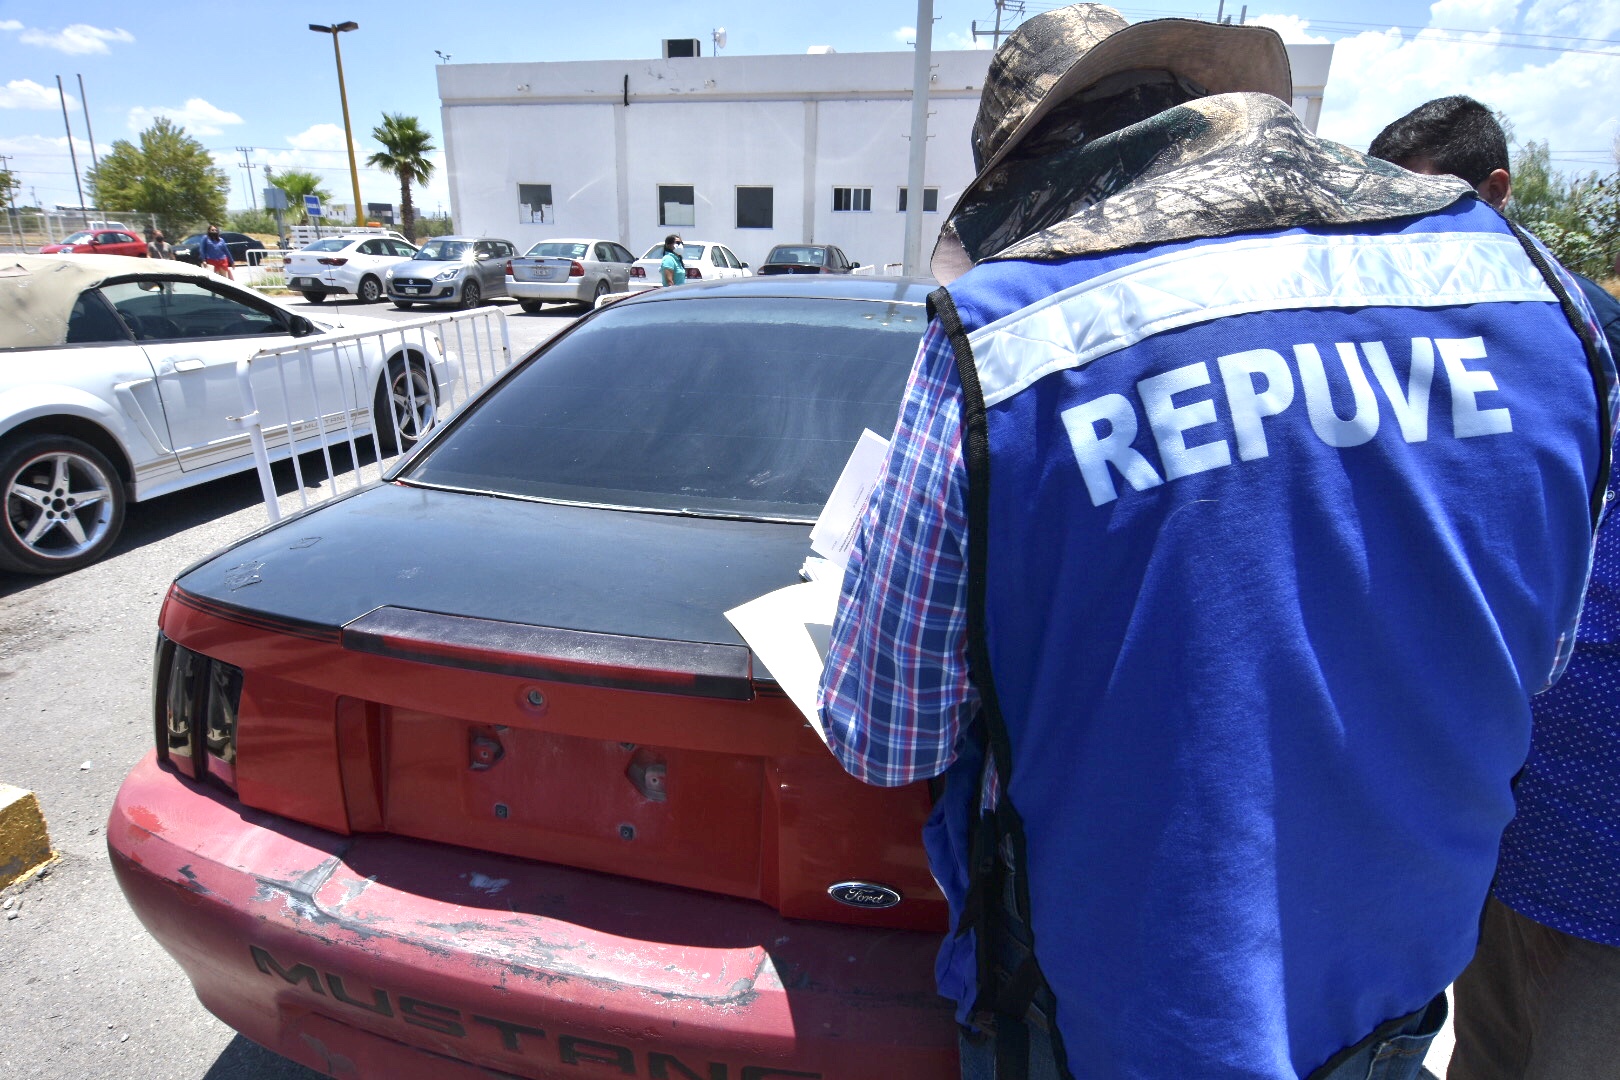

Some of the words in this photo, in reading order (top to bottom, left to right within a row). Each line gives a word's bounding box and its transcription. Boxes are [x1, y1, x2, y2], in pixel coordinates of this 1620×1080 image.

[303, 414, 347, 430] MUTAN
[1060, 335, 1514, 507] REPUVE
[844, 888, 884, 904] Ford
